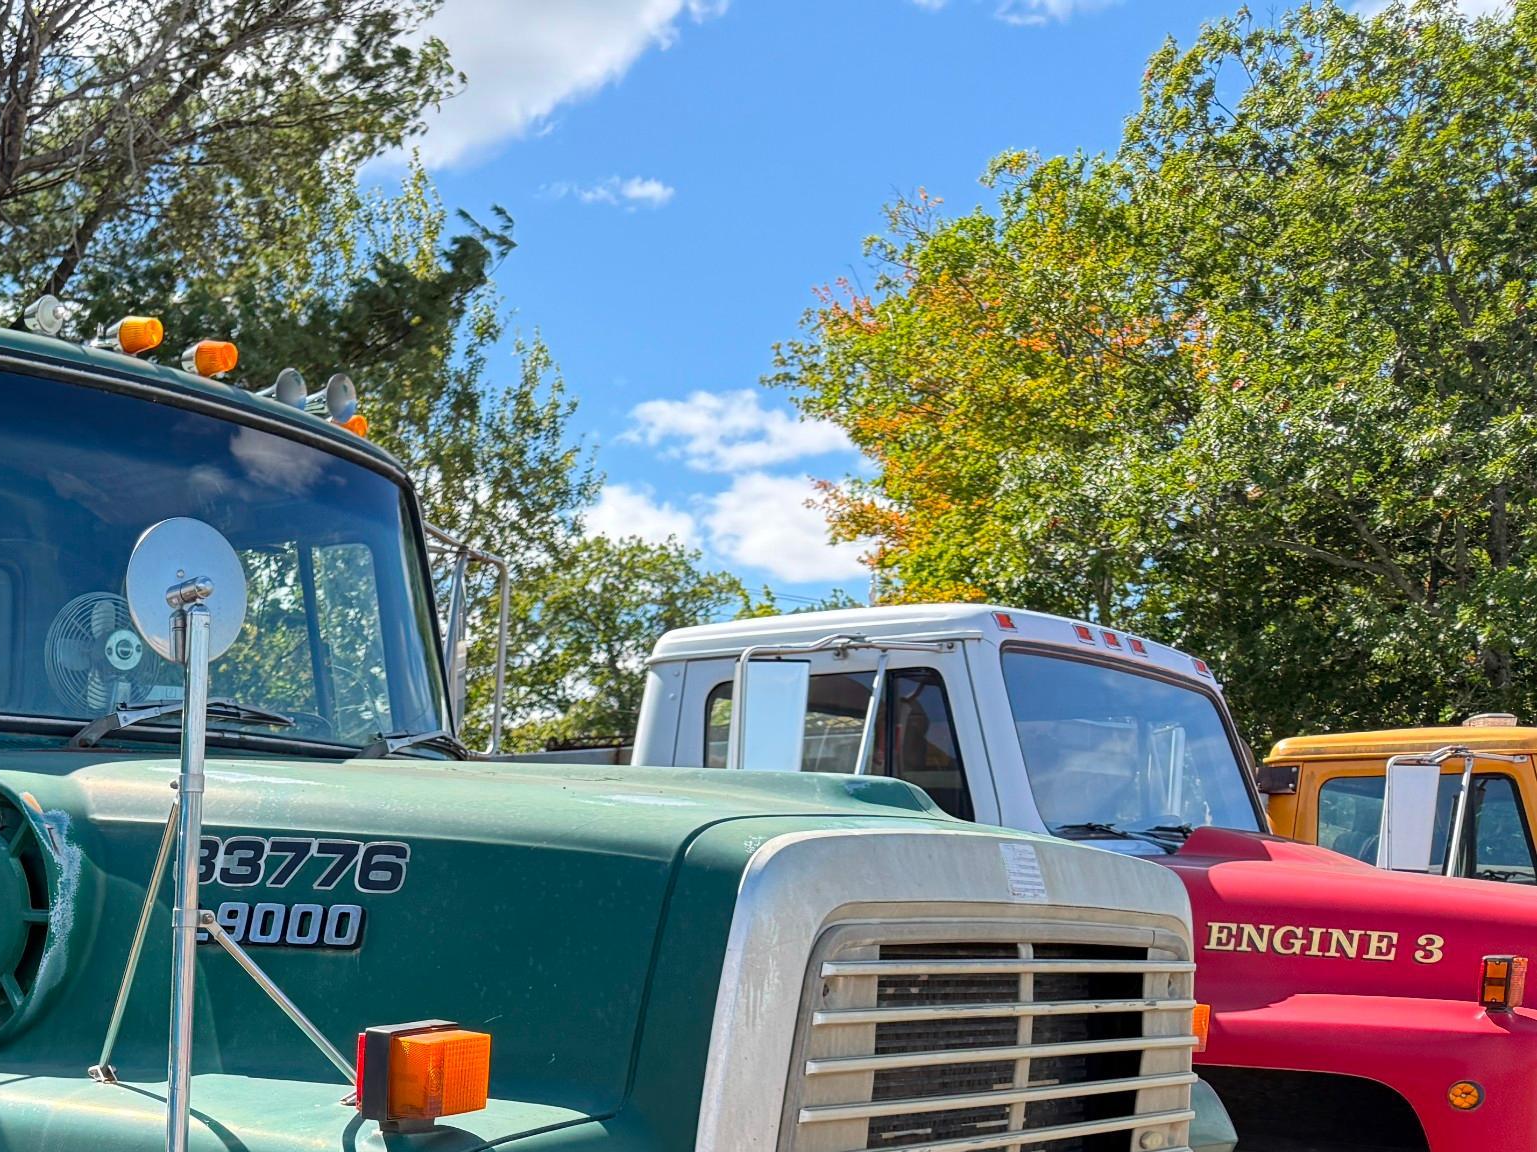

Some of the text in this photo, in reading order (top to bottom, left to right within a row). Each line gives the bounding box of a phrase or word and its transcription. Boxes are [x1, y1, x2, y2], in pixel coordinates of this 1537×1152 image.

[195, 901, 365, 947] 9000
[1204, 921, 1445, 964] ENGINE 3
